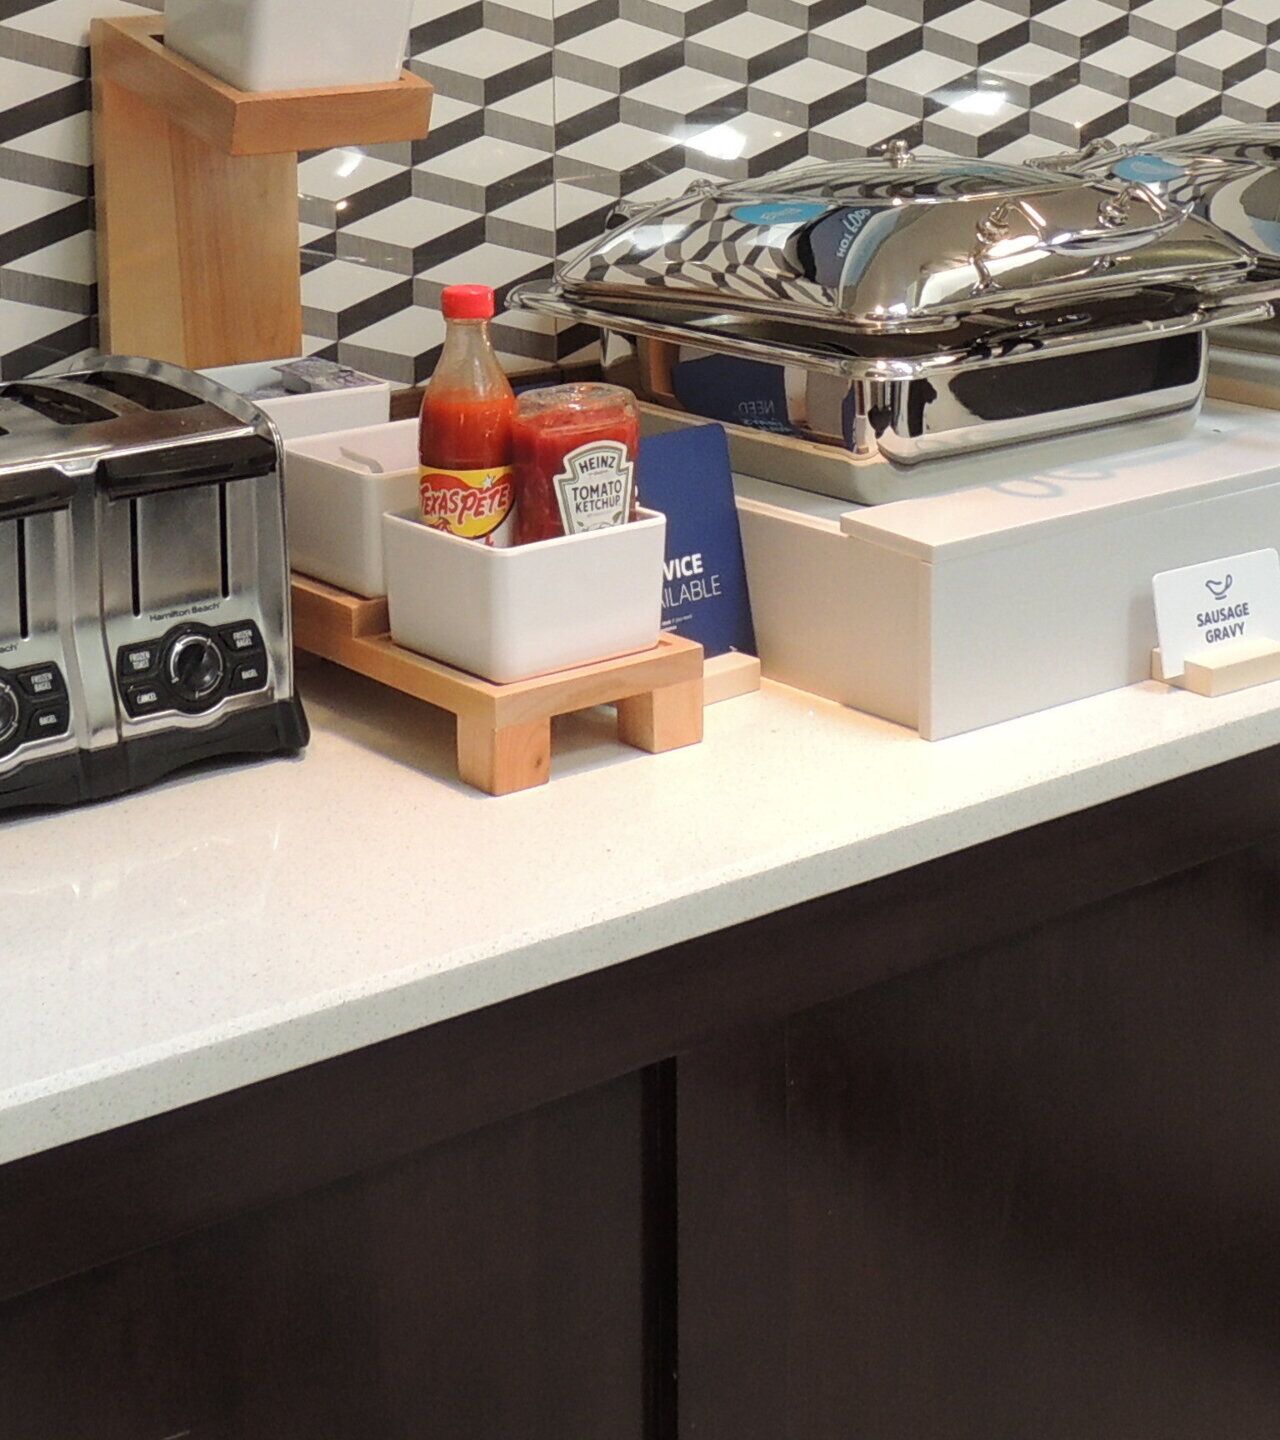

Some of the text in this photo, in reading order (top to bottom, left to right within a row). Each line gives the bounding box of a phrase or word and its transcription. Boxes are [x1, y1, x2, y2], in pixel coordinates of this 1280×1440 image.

[578, 455, 616, 474] HEINZ
[572, 480, 621, 501] TOMATO
[575, 496, 620, 514] KETCHUP
[150, 603, 220, 622] Hamilton Beach
[1196, 602, 1250, 627] SAUSAGE
[1205, 621, 1245, 644] GRAVY
